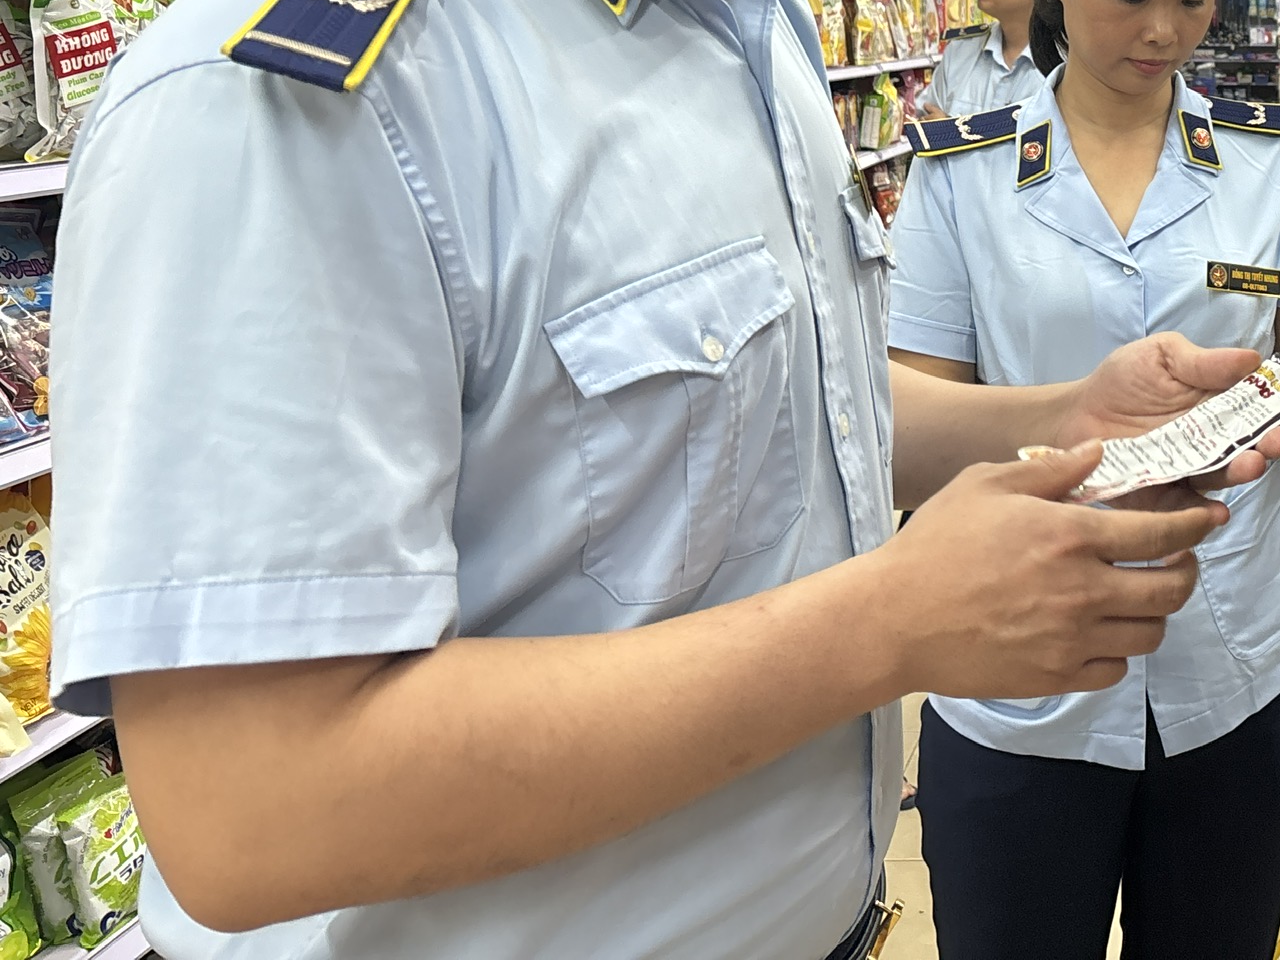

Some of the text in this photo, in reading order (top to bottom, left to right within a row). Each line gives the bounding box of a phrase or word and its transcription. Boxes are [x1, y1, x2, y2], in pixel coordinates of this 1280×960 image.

[54, 26, 110, 55] KHÔNG
[59, 46, 114, 75] ĐƯỜNG
[68, 70, 105, 88] Plum Can
[67, 83, 101, 102] Glucose
